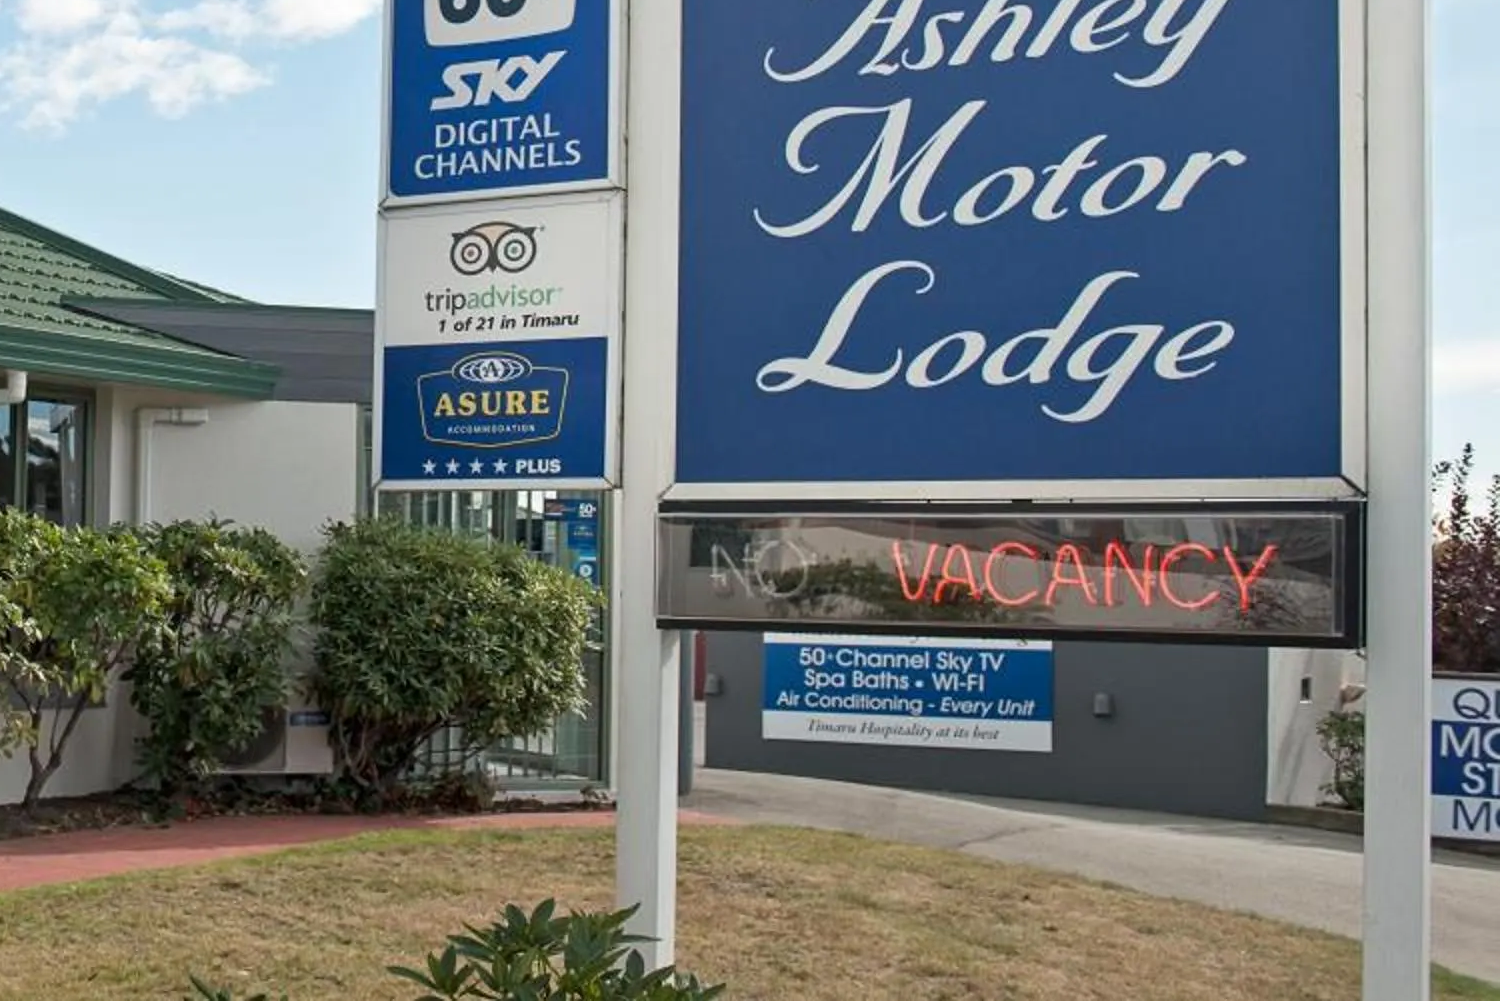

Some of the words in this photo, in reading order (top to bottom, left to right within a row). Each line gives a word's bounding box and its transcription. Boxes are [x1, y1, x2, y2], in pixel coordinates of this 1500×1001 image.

[429, 50, 568, 112] SKY
[435, 113, 560, 148] DIGITAL
[414, 140, 582, 180] CHANNELS
[753, 97, 1248, 238] Motor
[425, 284, 556, 315] tripadvisor
[438, 319, 447, 333] 1
[453, 316, 473, 332] of
[476, 316, 496, 331] 21
[500, 314, 517, 330] in
[521, 313, 580, 328] Timaru
[755, 259, 1236, 424] Lodge
[433, 390, 550, 417] ASURE
[515, 458, 562, 474] PLUS
[711, 540, 818, 599] NO
[892, 540, 1278, 614] VACANCY
[835, 649, 930, 670] Channel
[936, 651, 973, 675] Sky
[977, 652, 1005, 672] TV
[804, 668, 846, 690] Spa
[851, 670, 909, 691] Baths
[931, 672, 985, 692] WI-FI
[776, 690, 801, 707] Air
[804, 691, 924, 716] Conditioning
[940, 696, 993, 718] Every
[997, 698, 1036, 717] Unit
[1453, 687, 1500, 720] Q
[807, 718, 857, 734] Timaru
[860, 721, 932, 739] Hospitality
[935, 726, 951, 738] at
[953, 726, 969, 739] its
[972, 724, 1000, 740] best
[1452, 798, 1500, 833] M
